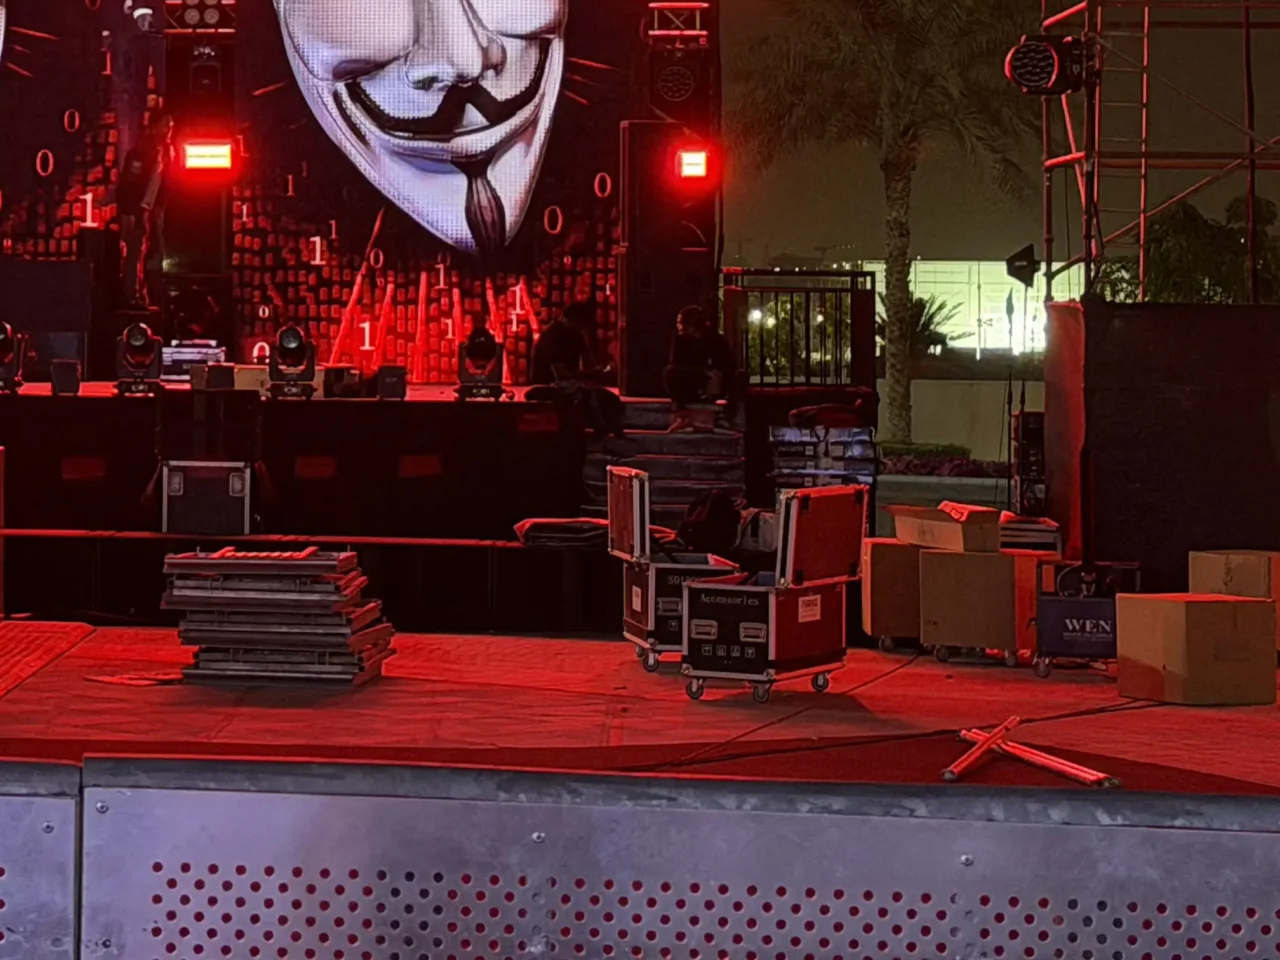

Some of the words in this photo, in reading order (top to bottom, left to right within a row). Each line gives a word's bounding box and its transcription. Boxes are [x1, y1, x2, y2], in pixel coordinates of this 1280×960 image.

[101, 48, 112, 74] 1
[64, 109, 80, 132] 0
[36, 149, 54, 177] 0
[286, 174, 295, 196] 1
[594, 172, 611, 198] 0
[79, 192, 98, 227] 1
[241, 204, 247, 222] 1
[544, 206, 563, 234] 0
[329, 220, 337, 239] 1
[309, 236, 326, 265] 1
[370, 248, 383, 268] 0
[434, 264, 448, 289] 1
[510, 283, 525, 314] 1
[259, 305, 269, 318] 0
[511, 313, 518, 332] 1
[360, 321, 375, 350] 1
[445, 319, 456, 338] 1
[700, 593, 760, 606] Accessories
[1064, 619, 1112, 632] WEN
